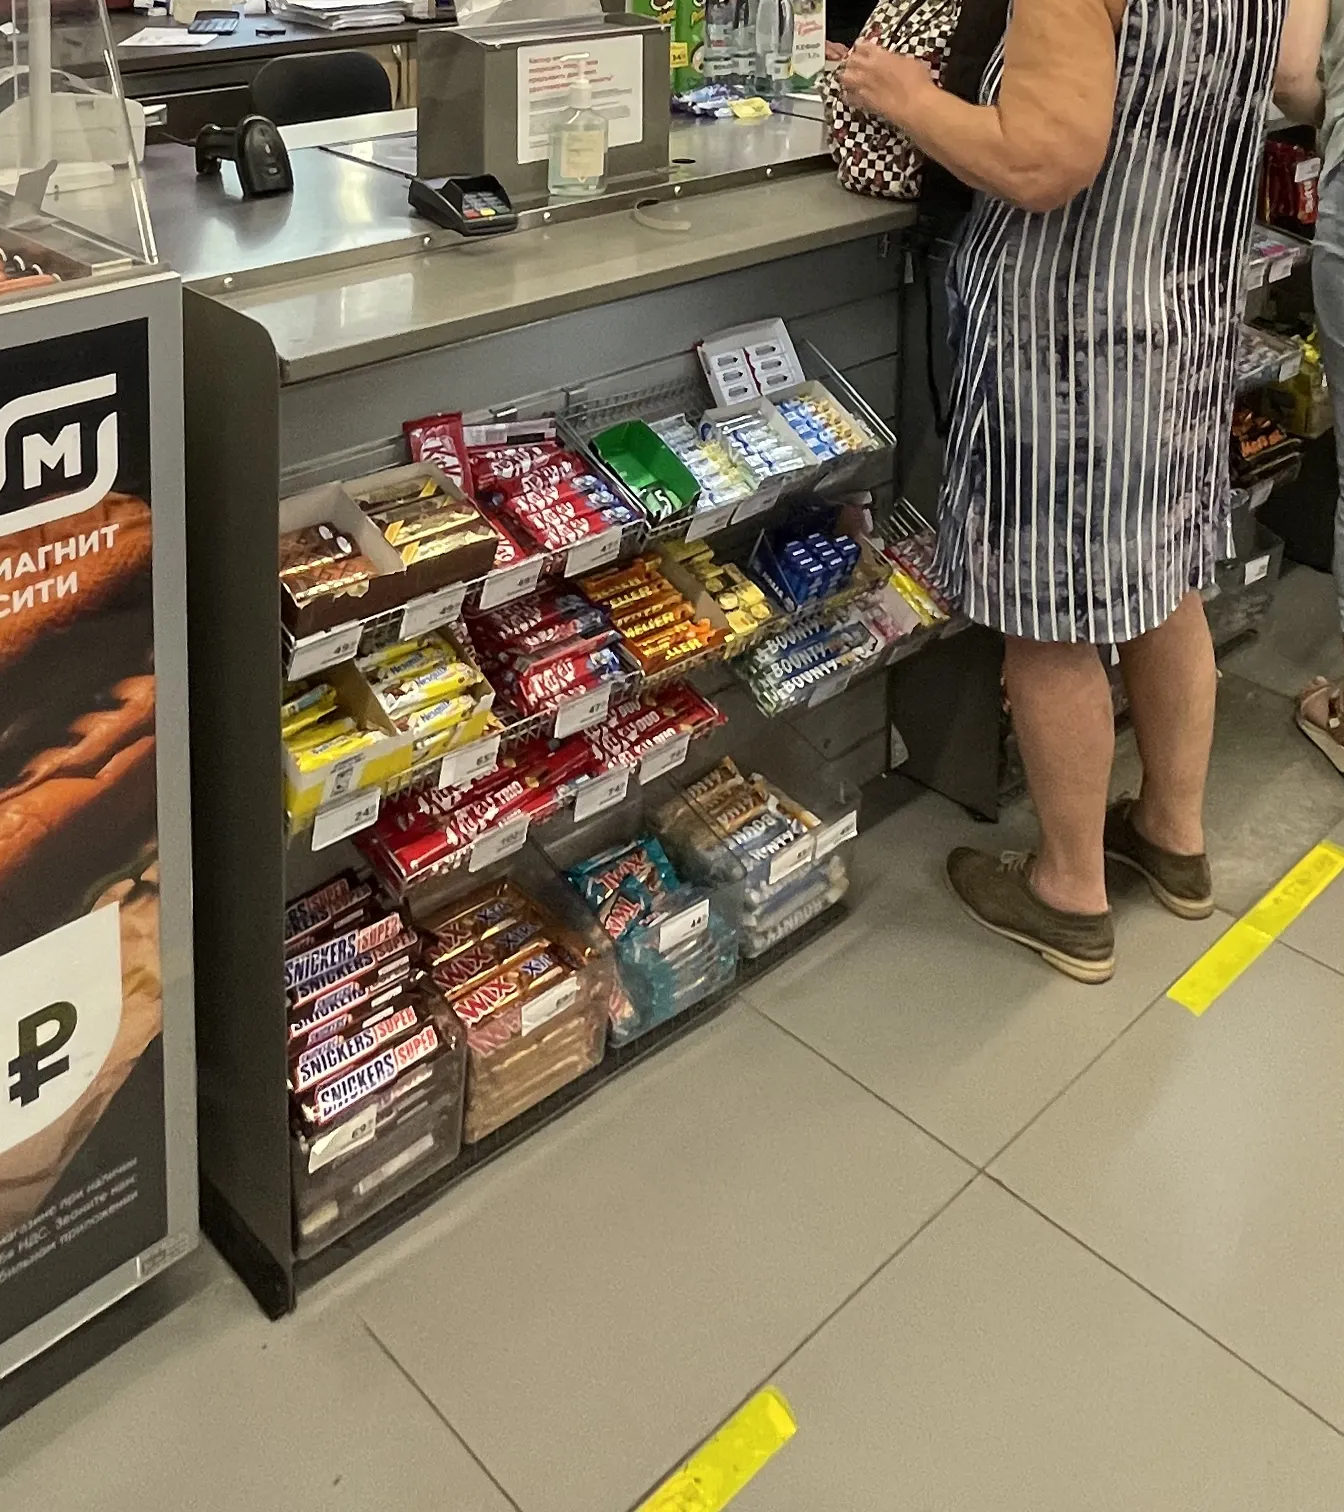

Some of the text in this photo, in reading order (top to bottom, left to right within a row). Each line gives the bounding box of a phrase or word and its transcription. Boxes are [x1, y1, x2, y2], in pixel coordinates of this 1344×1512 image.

[359, 916, 401, 950] SUPER
[300, 1007, 416, 1083] SNICKERS SUPER
[320, 1029, 436, 1106] SNICKERS SUPER
